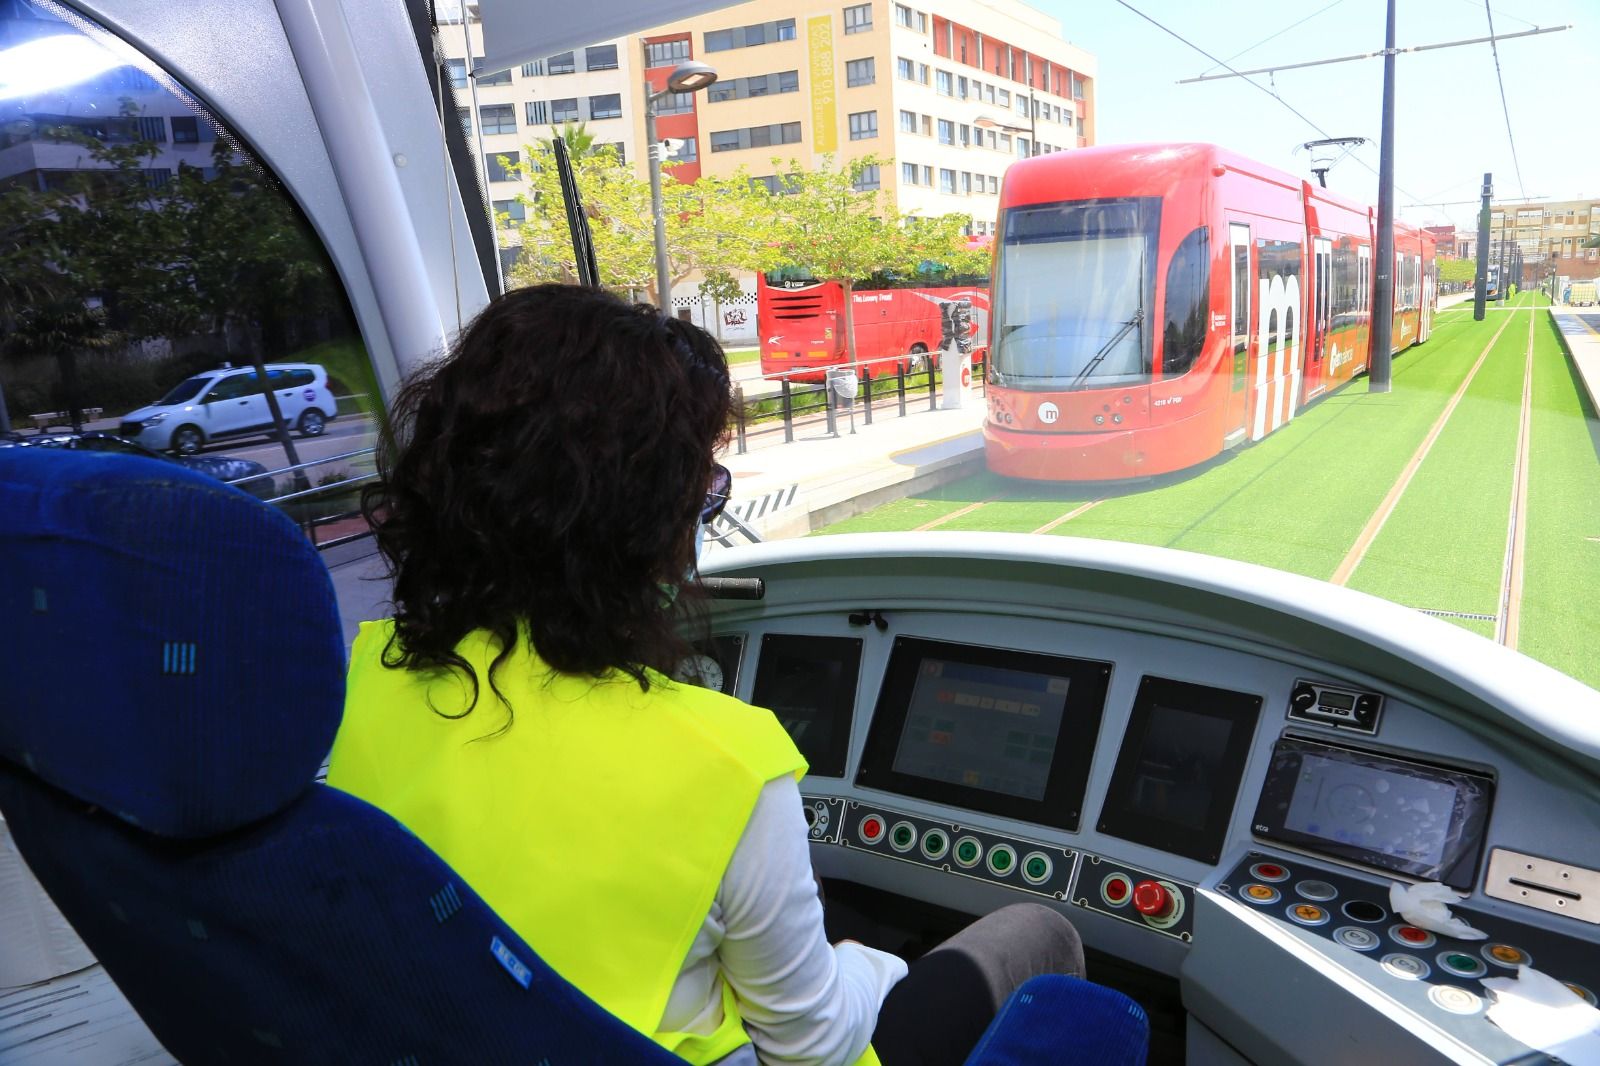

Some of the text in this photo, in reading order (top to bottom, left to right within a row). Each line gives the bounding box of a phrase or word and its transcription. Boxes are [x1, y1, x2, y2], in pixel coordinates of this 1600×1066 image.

[810, 25, 825, 146] ALQUILER DE VIVIENDAS
[820, 23, 833, 105] 910 888 202
[1252, 274, 1300, 442] m
[1046, 409, 1057, 419] m
